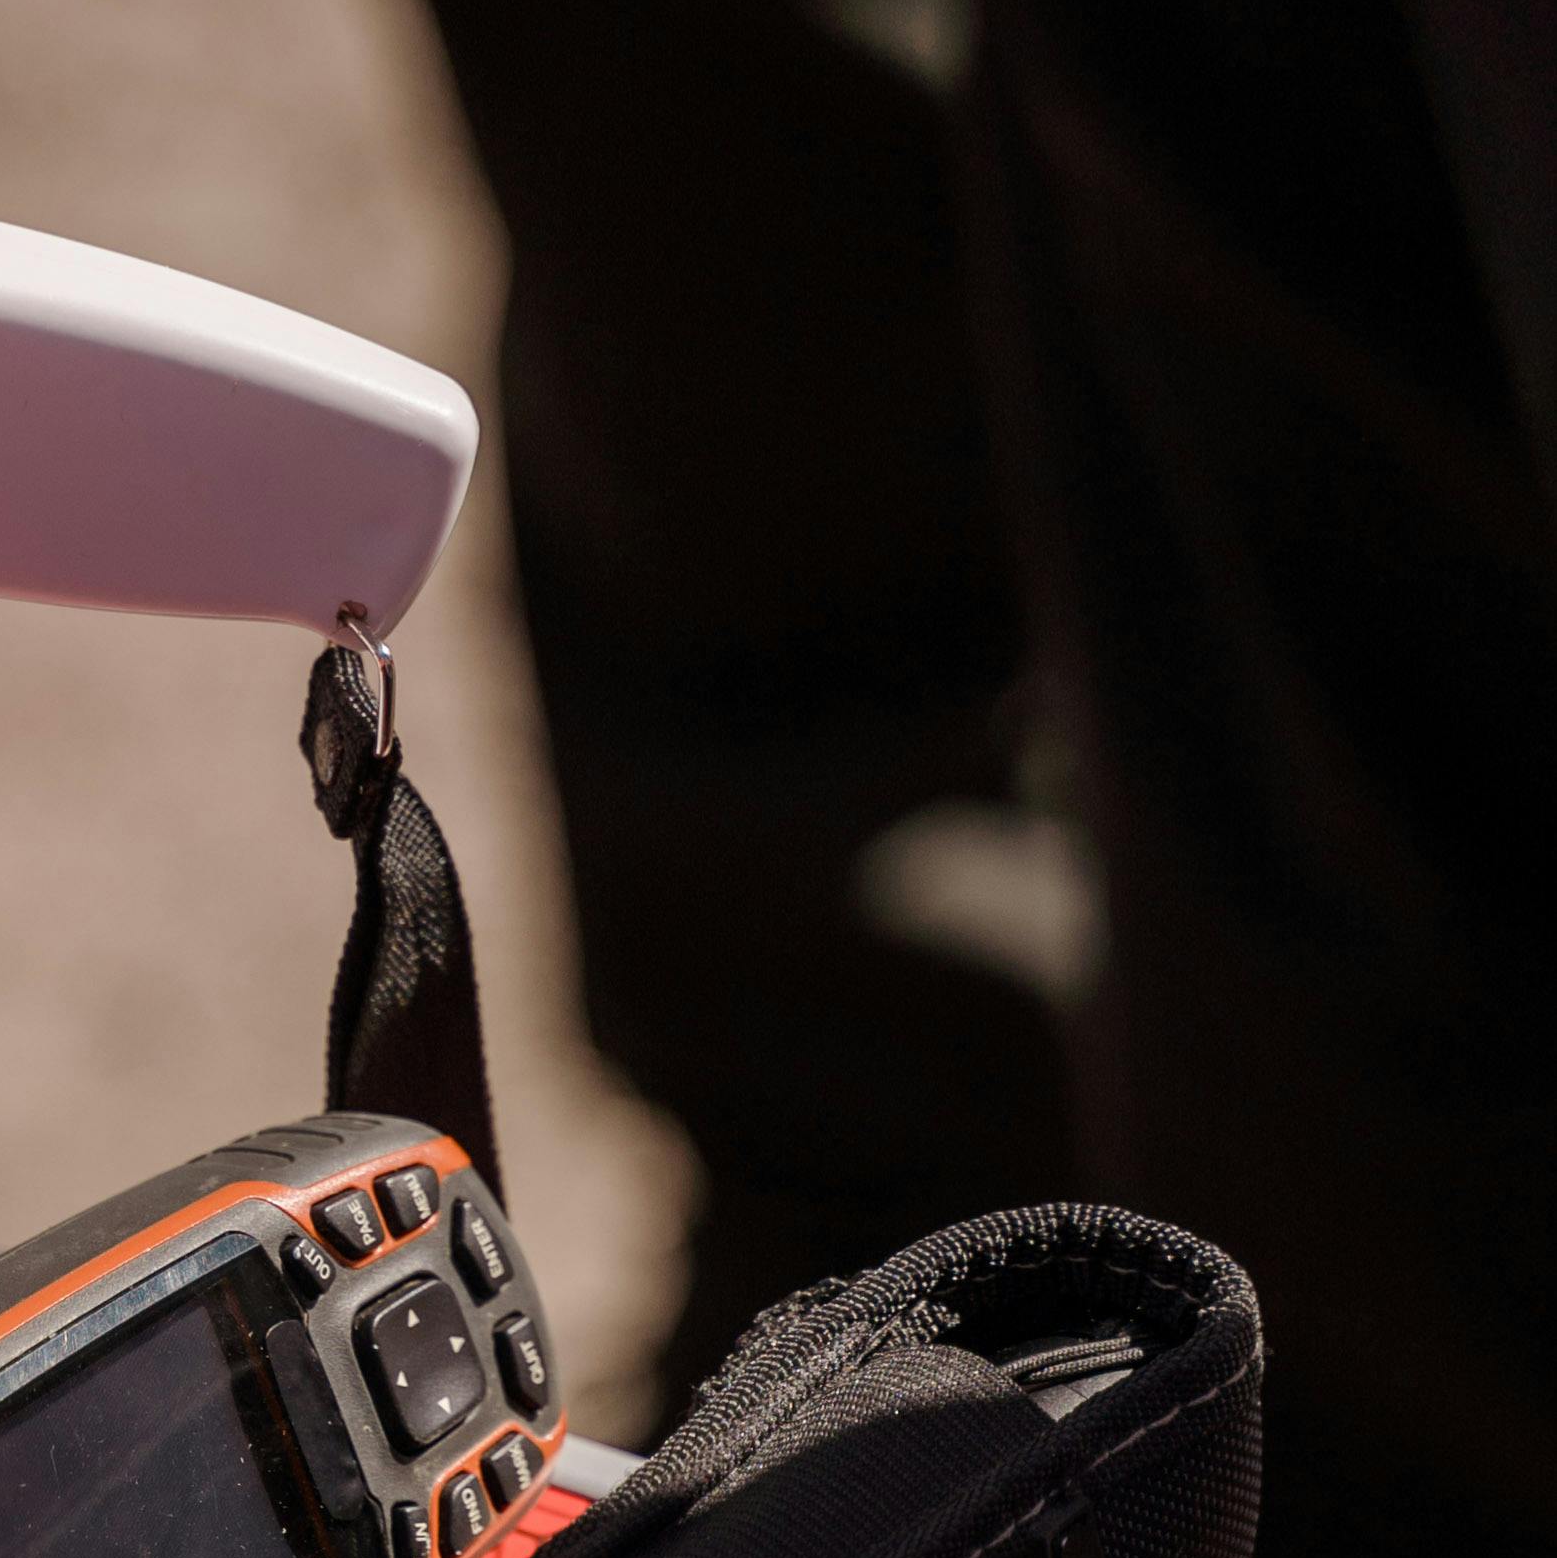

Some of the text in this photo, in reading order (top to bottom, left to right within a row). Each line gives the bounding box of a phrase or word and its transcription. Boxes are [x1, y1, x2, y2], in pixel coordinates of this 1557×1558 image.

[403, 1173, 432, 1220] MENU
[347, 1199, 377, 1246] PAGE
[304, 1246, 331, 1280] OUT
[470, 1217, 505, 1279] ENTER
[520, 1341, 545, 1385] QUIT
[509, 1443, 533, 1490] MARK
[414, 1522, 429, 1542] IN
[462, 1488, 484, 1536] FIND
